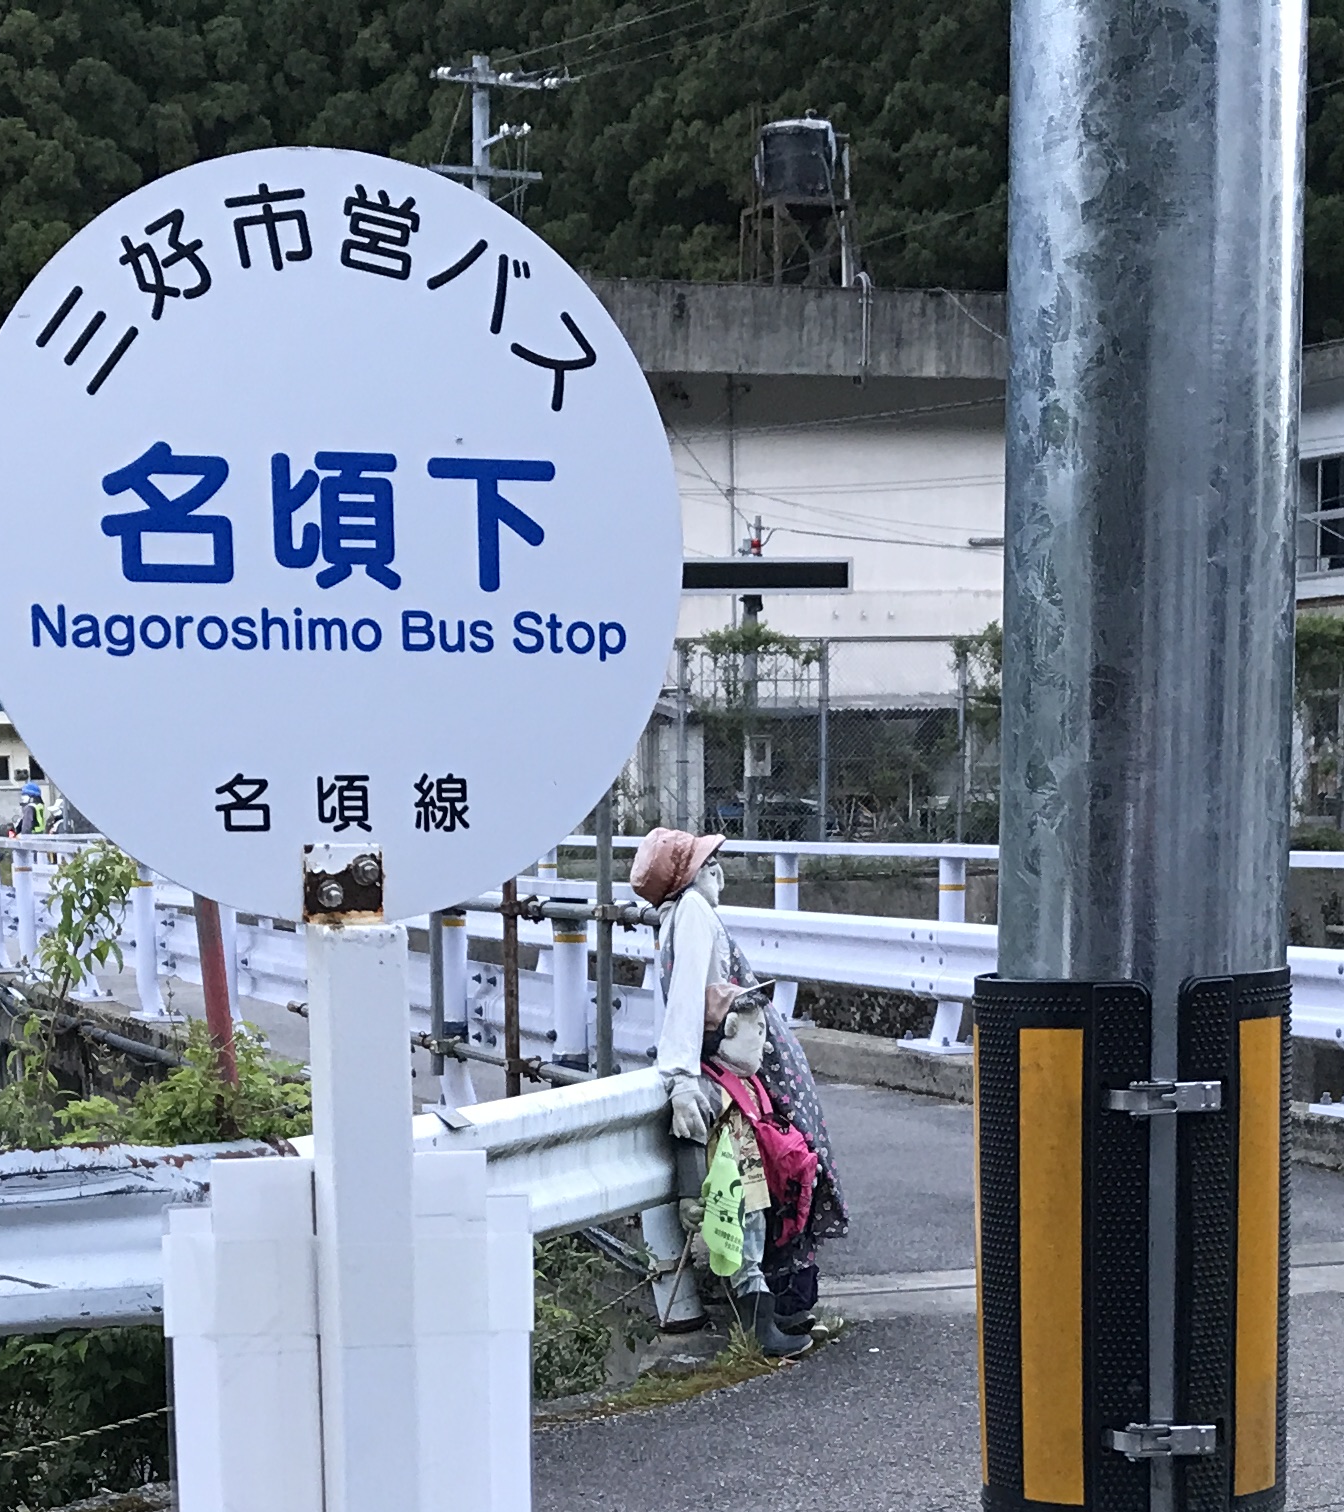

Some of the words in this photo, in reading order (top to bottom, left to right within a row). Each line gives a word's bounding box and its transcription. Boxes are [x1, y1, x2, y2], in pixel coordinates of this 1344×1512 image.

[34, 182, 598, 413] 三好市営バス
[99, 440, 557, 594] 名頃下
[30, 603, 384, 658] Nagoroshimo
[401, 608, 495, 655] Bus
[512, 609, 628, 663] Stop
[215, 772, 472, 834] 名頃線
